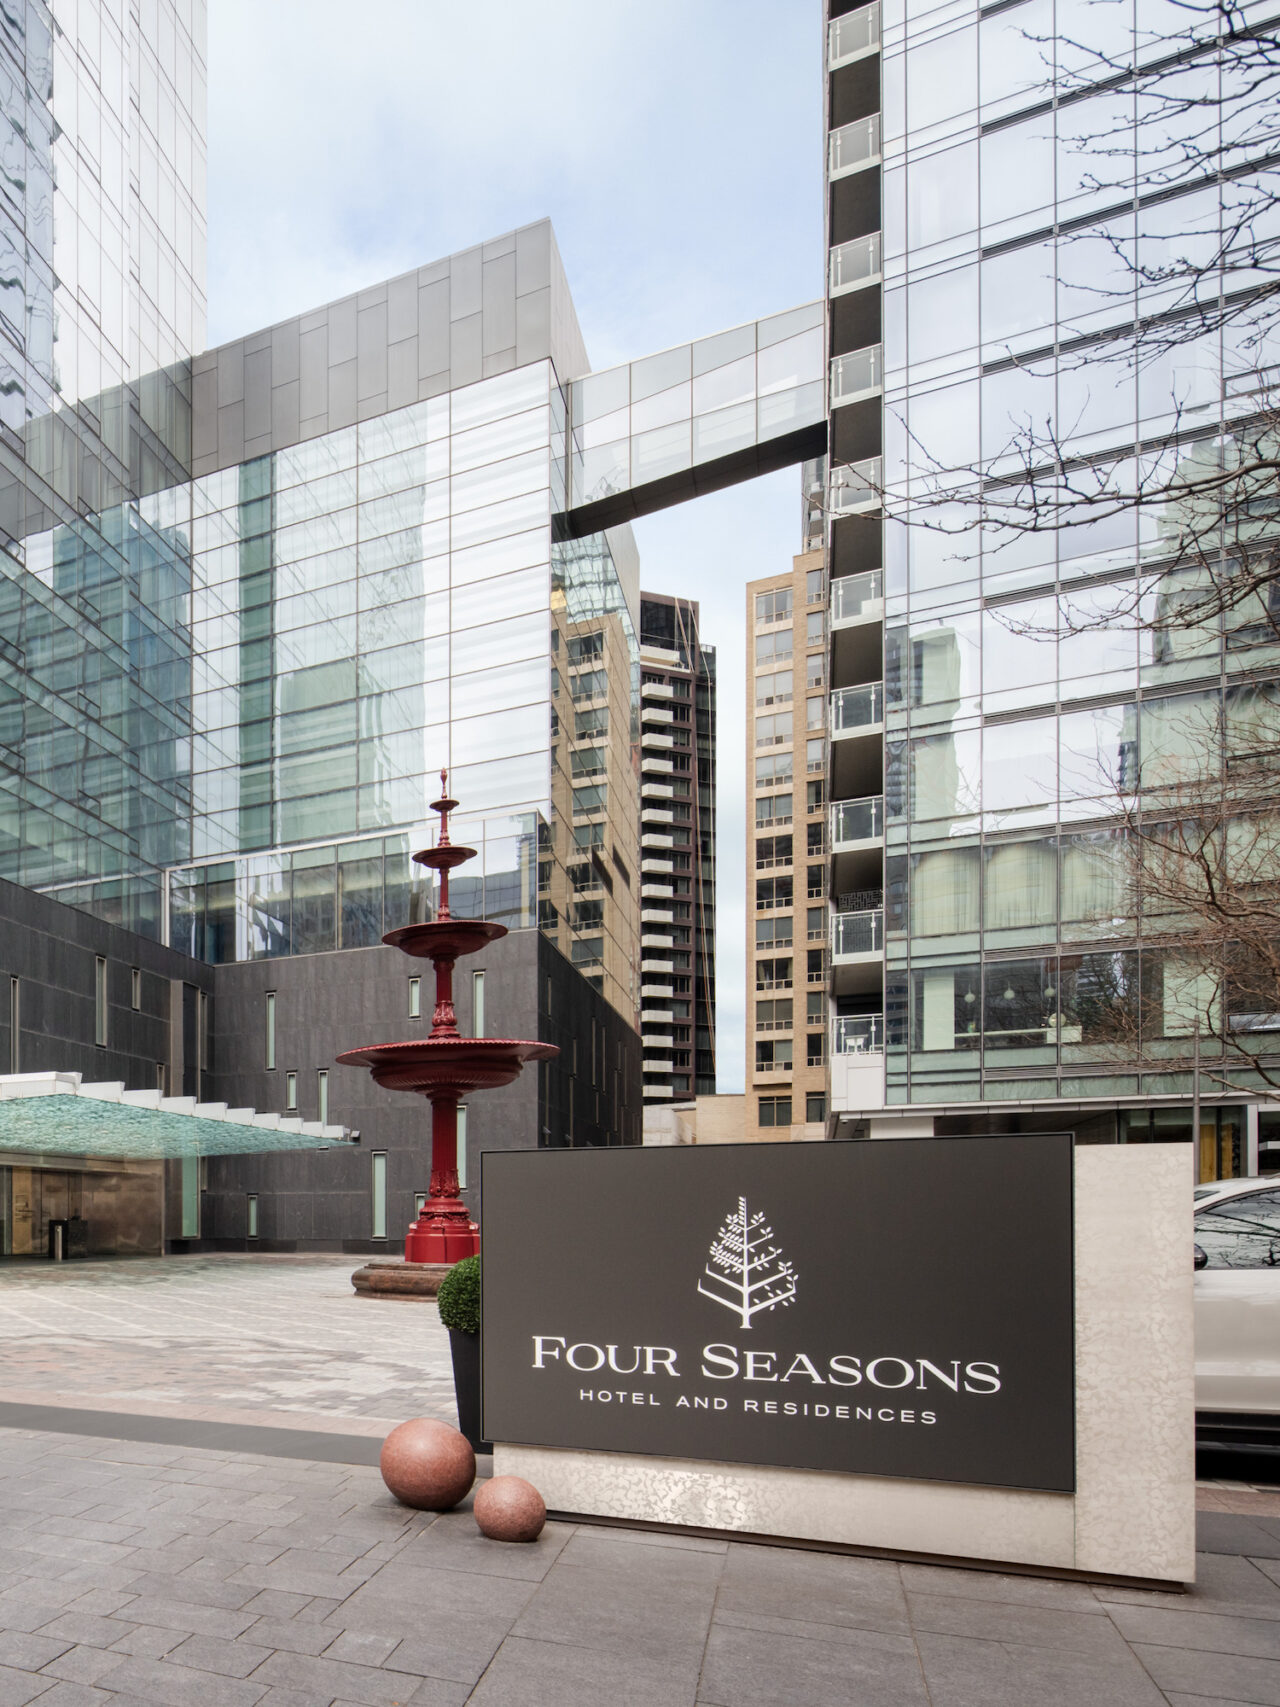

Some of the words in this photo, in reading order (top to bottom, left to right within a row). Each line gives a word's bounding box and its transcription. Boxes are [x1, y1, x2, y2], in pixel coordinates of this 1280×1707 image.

[532, 1335, 680, 1377] FOUR
[701, 1343, 1001, 1394] SEASONS
[580, 1388, 661, 1406] HOTEL
[676, 1395, 728, 1411] AND
[744, 1399, 937, 1425] RESIDENCES
